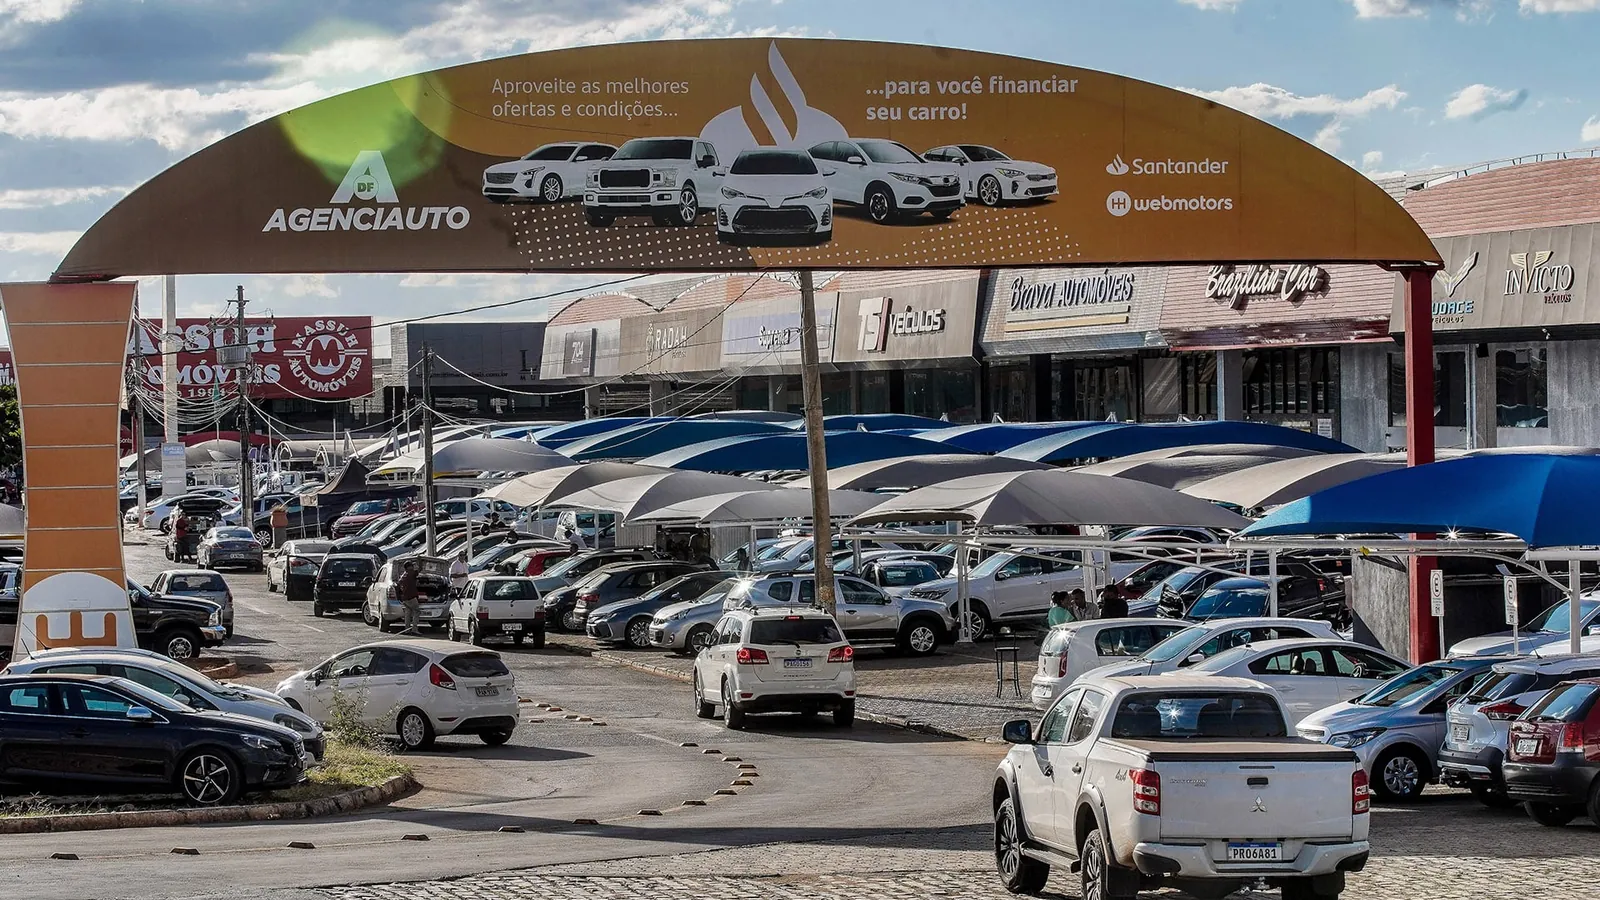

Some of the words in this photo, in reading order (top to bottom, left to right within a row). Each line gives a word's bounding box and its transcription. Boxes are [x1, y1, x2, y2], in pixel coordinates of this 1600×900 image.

[492, 78, 576, 98] Aproveite
[581, 82, 600, 94] as
[605, 78, 689, 94] melhores
[866, 79, 929, 98] ...para
[937, 76, 982, 94] você
[989, 75, 1078, 94] financiar
[492, 101, 555, 117] ofertas
[563, 105, 572, 117] e
[577, 101, 678, 120] condições...
[866, 106, 901, 120] seu
[908, 103, 967, 120] carro!
[1132, 157, 1229, 175] Santander
[357, 182, 374, 192] DF
[1134, 195, 1233, 211] webmotors
[262, 206, 470, 232] AGENCIAUTO
[1504, 251, 1575, 295] INVICTO
[1011, 275, 1056, 311] Brava
[1058, 268, 1134, 307] AUTOMÓVEIS
[1205, 264, 1280, 309] Brazilian
[1280, 264, 1319, 301] Car
[1432, 300, 1474, 316] UDACE
[889, 304, 946, 337] VEÍCULOS
[292, 320, 359, 348] MASSUH
[289, 356, 362, 393] AUTOMÓVEIS
